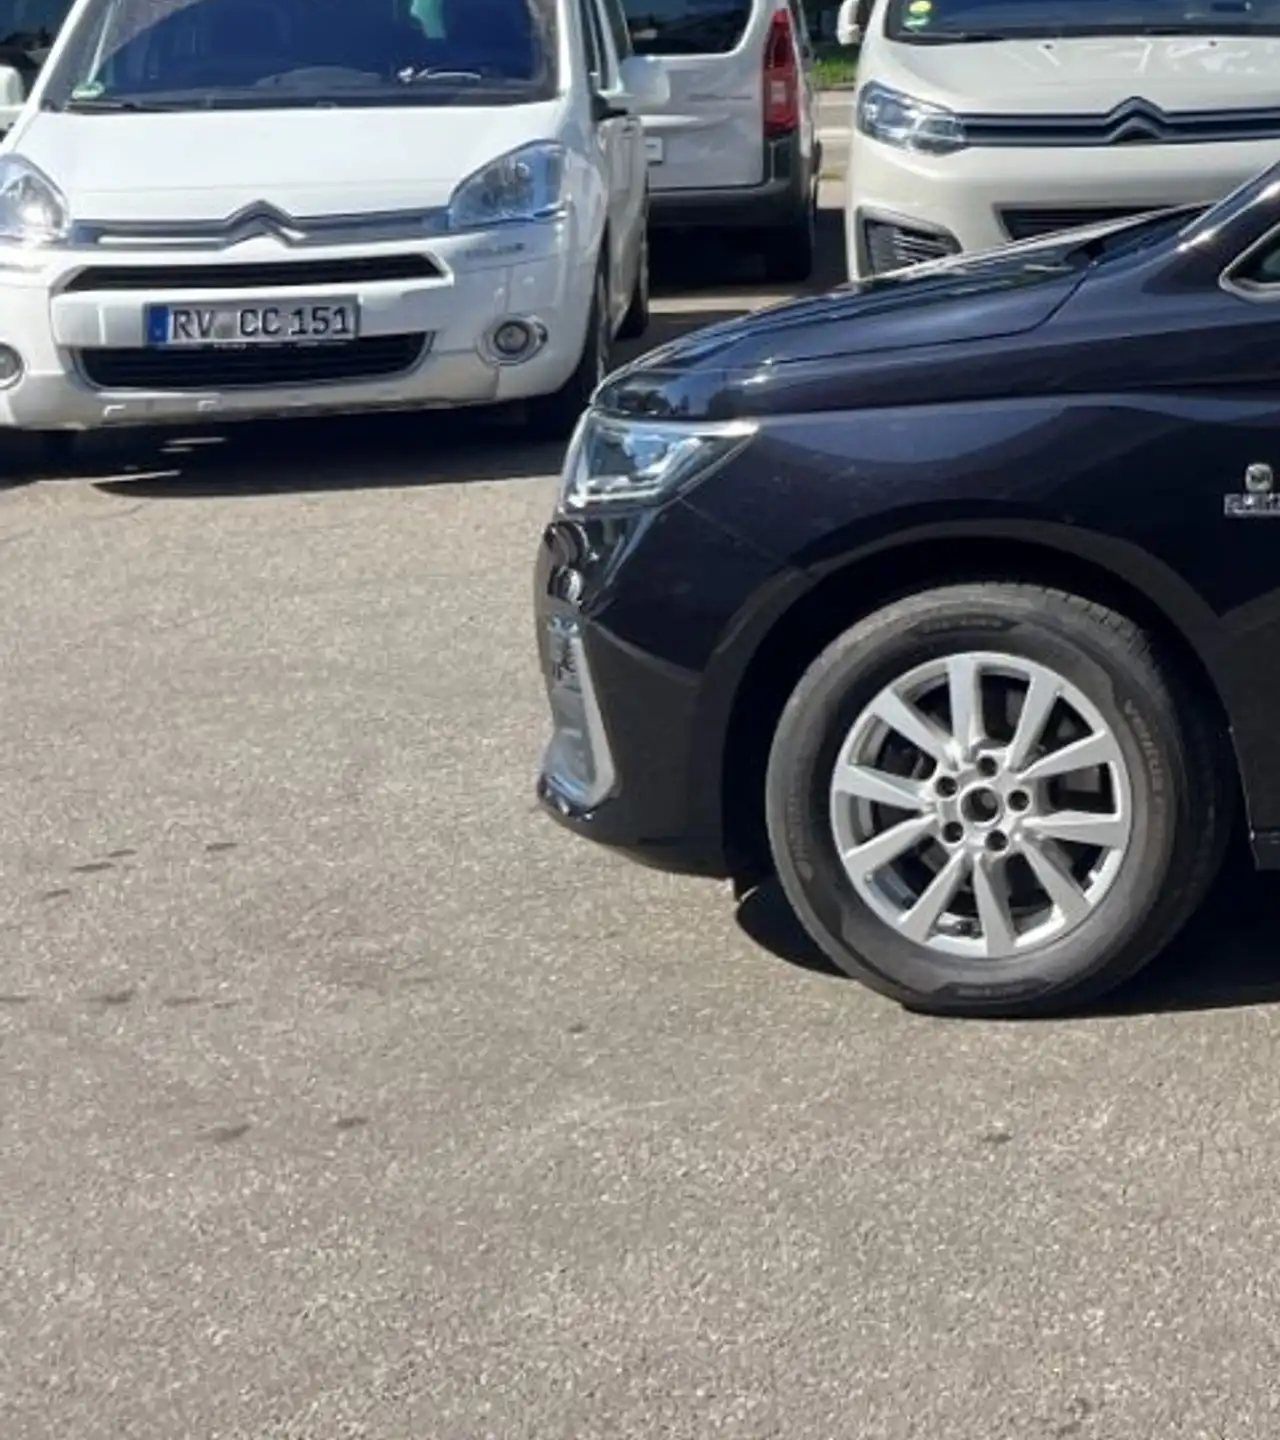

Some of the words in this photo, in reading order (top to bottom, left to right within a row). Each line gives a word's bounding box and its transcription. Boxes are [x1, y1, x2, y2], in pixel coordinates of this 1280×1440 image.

[173, 309, 215, 340] RV
[239, 308, 281, 337] CC
[289, 305, 349, 337] 151
